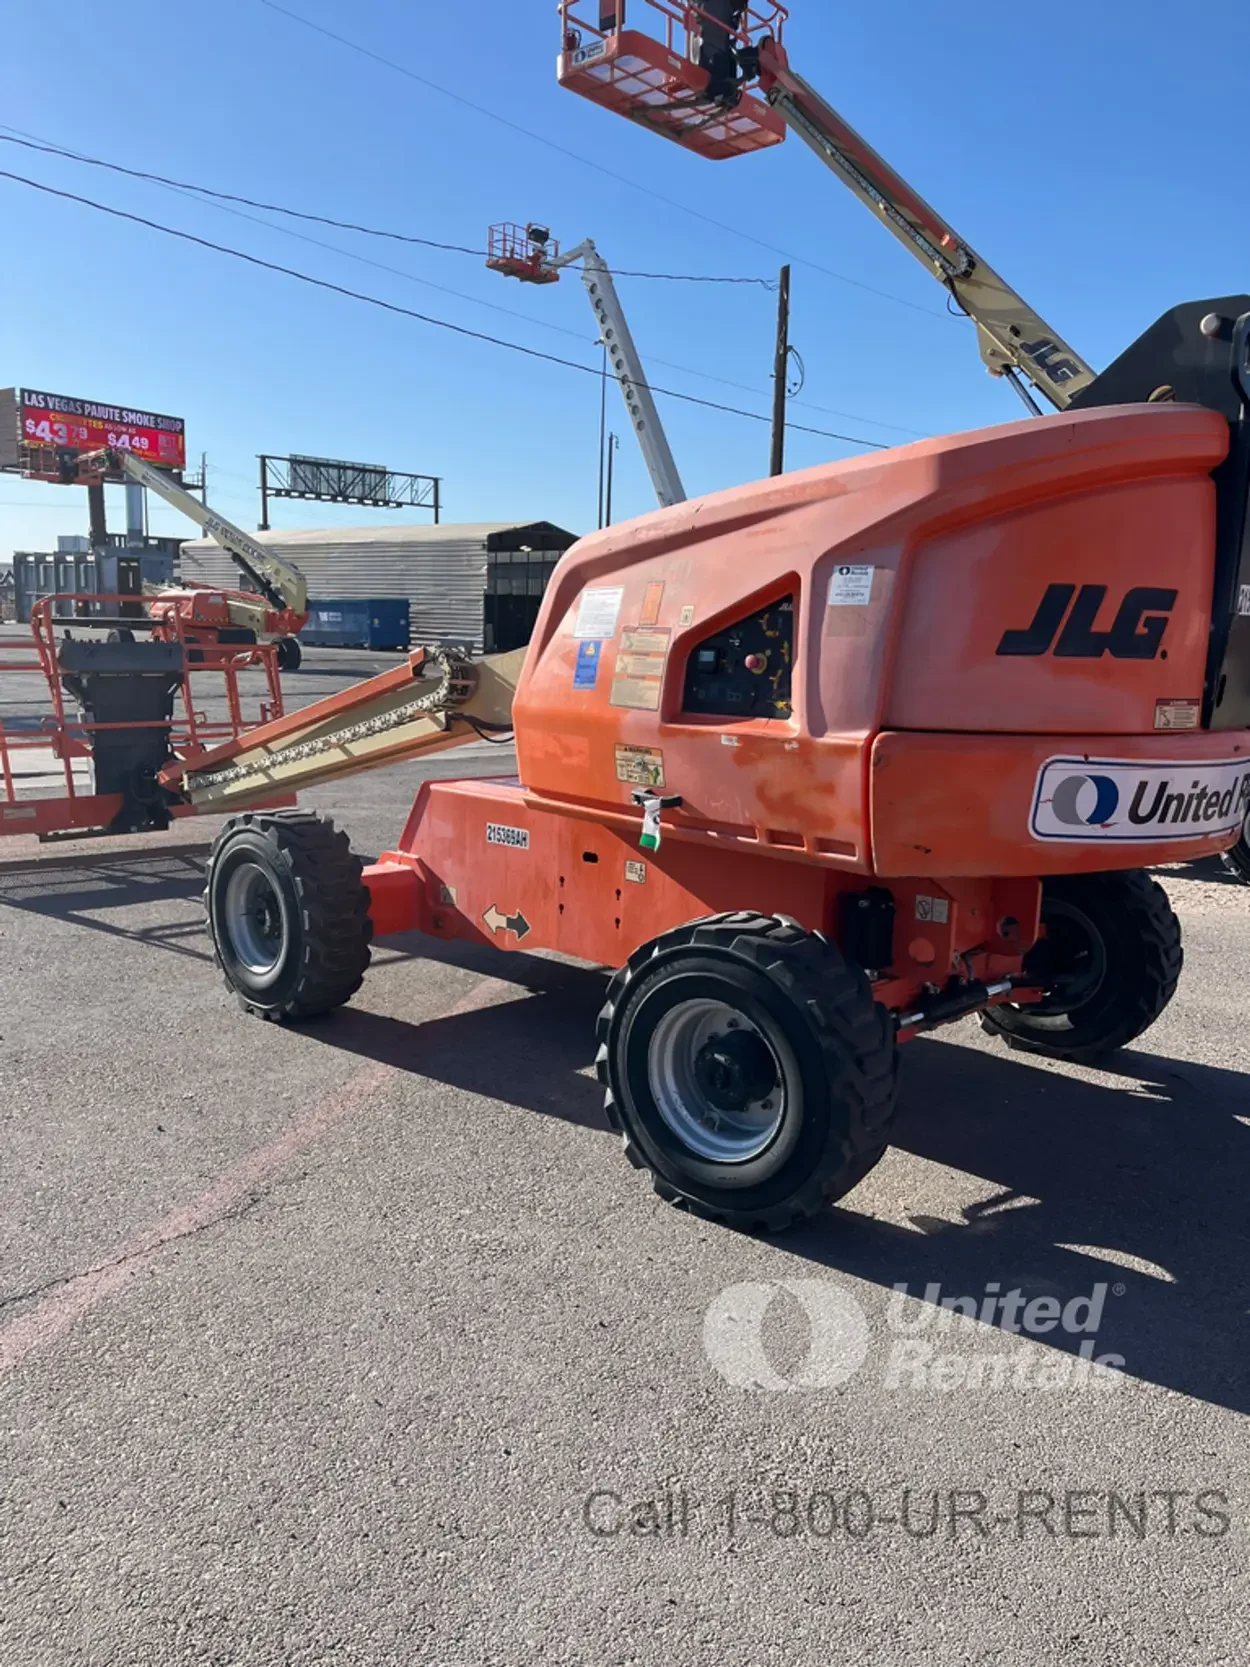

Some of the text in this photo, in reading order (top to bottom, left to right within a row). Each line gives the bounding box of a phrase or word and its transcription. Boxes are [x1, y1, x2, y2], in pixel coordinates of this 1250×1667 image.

[1019, 339, 1081, 384] JLG
[24, 392, 182, 433] LAS VEGAS PAIUTE SMOKE SHOP
[995, 583, 1178, 659] JLG
[1127, 776, 1239, 825] United
